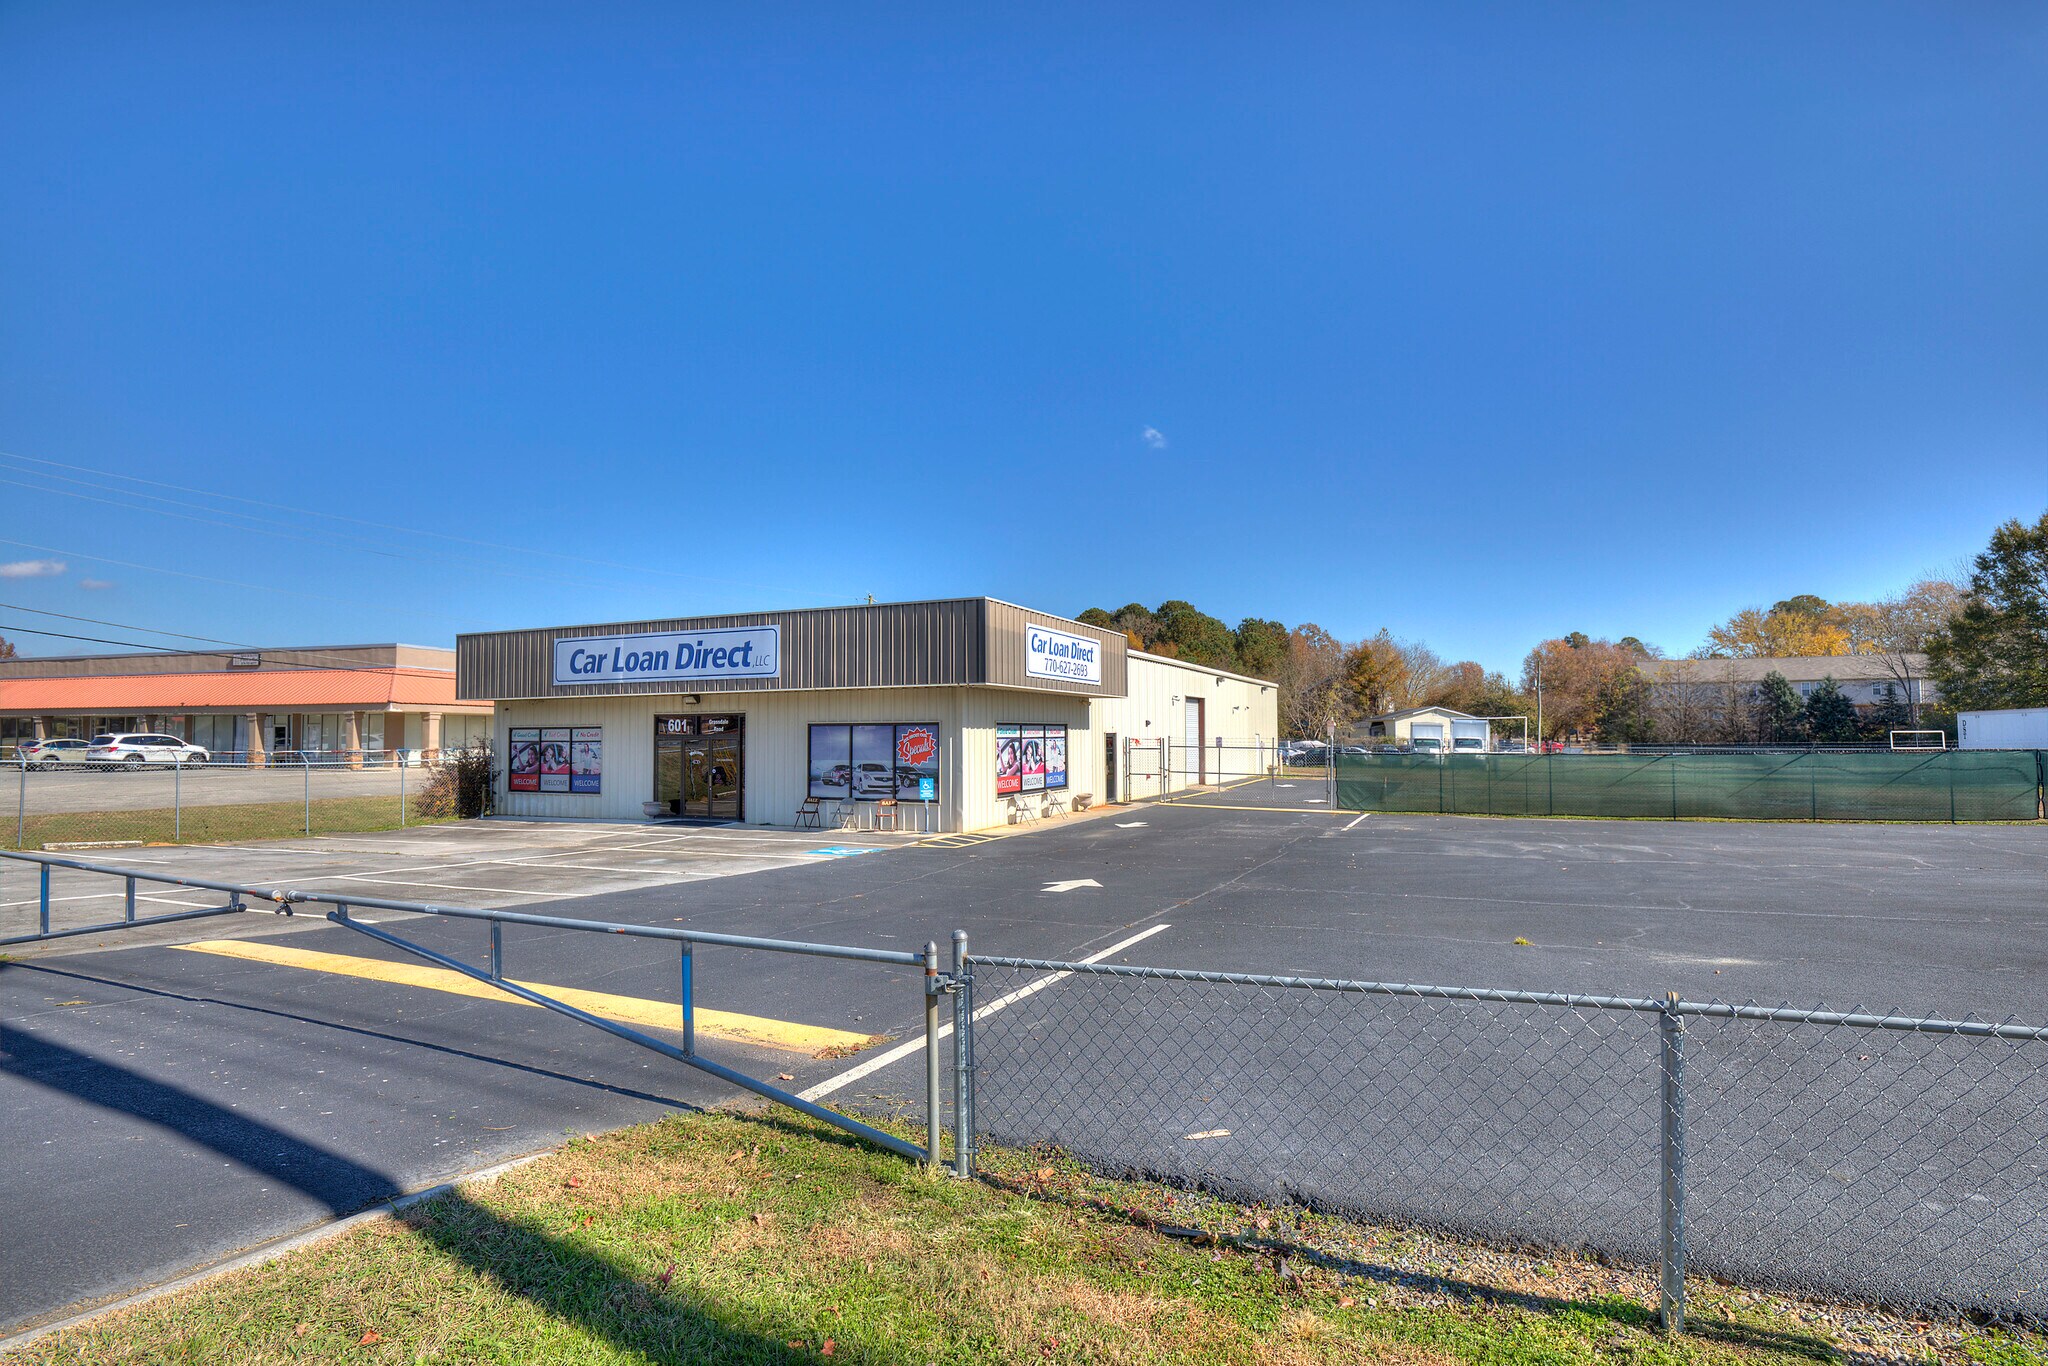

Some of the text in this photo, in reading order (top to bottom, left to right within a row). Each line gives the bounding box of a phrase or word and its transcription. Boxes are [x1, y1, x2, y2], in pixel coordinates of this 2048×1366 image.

[1031, 633, 1094, 663] Car Loan Direct
[570, 649, 608, 674] Car
[612, 646, 669, 673] Loan
[675, 640, 752, 669] Direct
[1044, 657, 1088, 677] 770-627-2693
[668, 718, 687, 732] 601
[997, 778, 1019, 789] WELCOME
[1024, 776, 1043, 786] WELCOME
[1046, 774, 1064, 783] WELCOME
